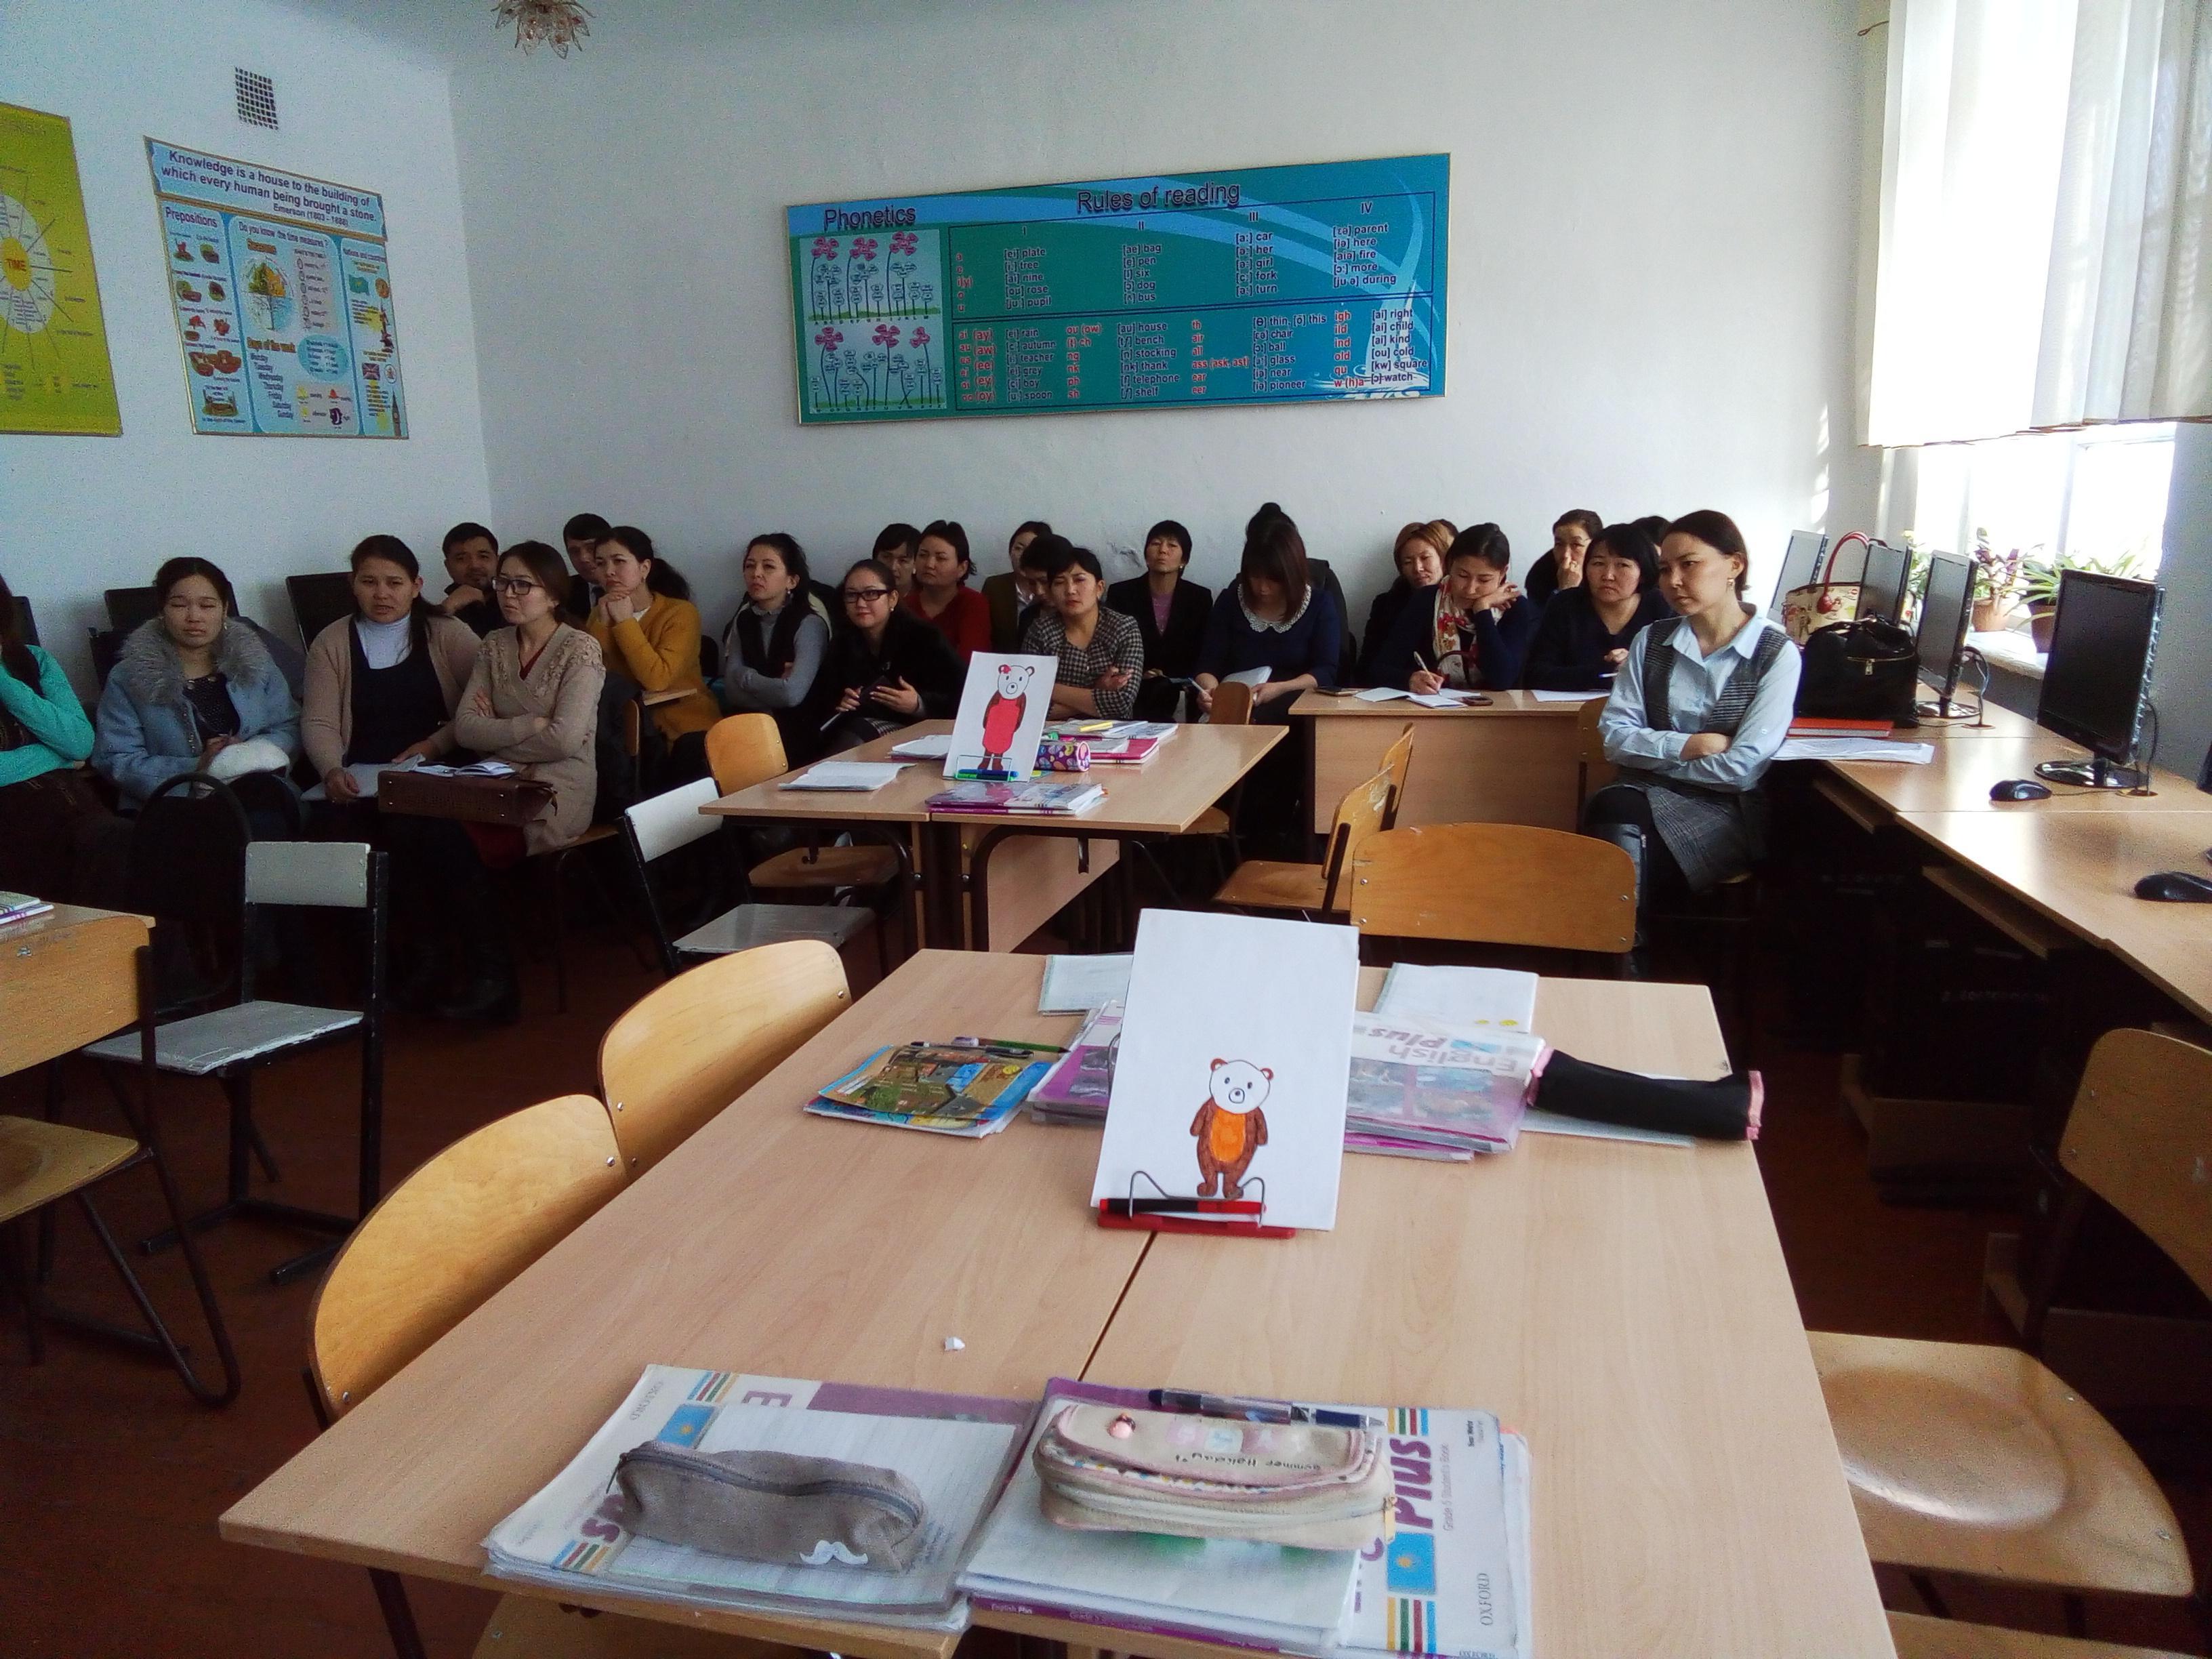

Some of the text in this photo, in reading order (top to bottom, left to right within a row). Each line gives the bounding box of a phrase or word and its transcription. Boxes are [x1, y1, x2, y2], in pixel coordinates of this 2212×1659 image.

[169, 150, 234, 176] Knowledge
[237, 167, 245, 178] is
[258, 171, 289, 188] house
[291, 181, 302, 191] to
[304, 183, 319, 195] the
[322, 186, 359, 207] building
[361, 197, 369, 206] of
[162, 166, 197, 182] which
[200, 175, 230, 191] every
[234, 181, 270, 198] human
[273, 189, 300, 207] being
[303, 197, 340, 214] brought
[350, 208, 377, 222] stone.
[1078, 182, 1240, 211] Rules of reading
[273, 203, 305, 218] Emerson
[1361, 203, 1372, 213] IV
[165, 207, 218, 228] Prepositions
[824, 205, 916, 230] Phonetics
[1354, 224, 1389, 234] parent
[1256, 232, 1273, 241] car
[1353, 238, 1376, 247] here
[1022, 248, 1046, 258] plate
[1143, 245, 1161, 254] bag
[1256, 245, 1273, 254] her
[1359, 250, 1376, 259] fire
[5, 258, 27, 271] TIME
[1020, 262, 1038, 270] tree
[1256, 258, 1273, 268] girl
[1351, 263, 1378, 272] more
[1256, 271, 1277, 281] fork
[1362, 274, 1397, 285] during
[1137, 281, 1155, 291] dog
[1256, 285, 1277, 293] turn
[1027, 297, 1051, 306] pupil
[1138, 293, 1155, 302] bus
[1309, 314, 1327, 324] this
[1335, 310, 1351, 321] igh
[1390, 309, 1413, 319] right
[1081, 324, 1101, 334] (ow)
[1139, 323, 1167, 331] house
[1334, 325, 1348, 334] ild
[1390, 321, 1414, 331] child
[973, 329, 993, 340] (ay)
[1022, 329, 1039, 337] rain
[1271, 330, 1293, 340] chair
[1135, 335, 1164, 345] bench
[1334, 338, 1351, 348] ind
[1389, 334, 1410, 344] kind
[975, 345, 996, 355] (aw)
[1022, 341, 1056, 350] autumn
[1269, 343, 1286, 352] ball
[1067, 352, 1080, 361] ng
[1135, 348, 1177, 359] stocking
[1334, 352, 1351, 361] old
[1393, 347, 1414, 356] cold
[1021, 353, 1054, 362] teacher
[1270, 355, 1296, 365] glass
[975, 361, 994, 371] (ee)
[1067, 364, 1080, 373] nk
[1141, 361, 1168, 370] thank
[1192, 361, 1207, 369] ass
[1394, 360, 1427, 369] square
[1023, 367, 1042, 376] grey
[1270, 369, 1292, 377] near
[1334, 365, 1347, 375] qu
[975, 376, 994, 386] (ey)
[1067, 377, 1080, 386] ph
[1133, 374, 1180, 385] telephone
[1192, 373, 1207, 382] ear
[1385, 373, 1413, 382] watch
[1023, 378, 1040, 388] boy
[1270, 380, 1306, 390] pioneer
[1025, 391, 1052, 400] spoon
[1068, 390, 1080, 398] sh
[1135, 387, 1159, 396] shelf
[976, 392, 995, 402] (oy)
[1476, 1573, 1494, 1626] OXFORD
